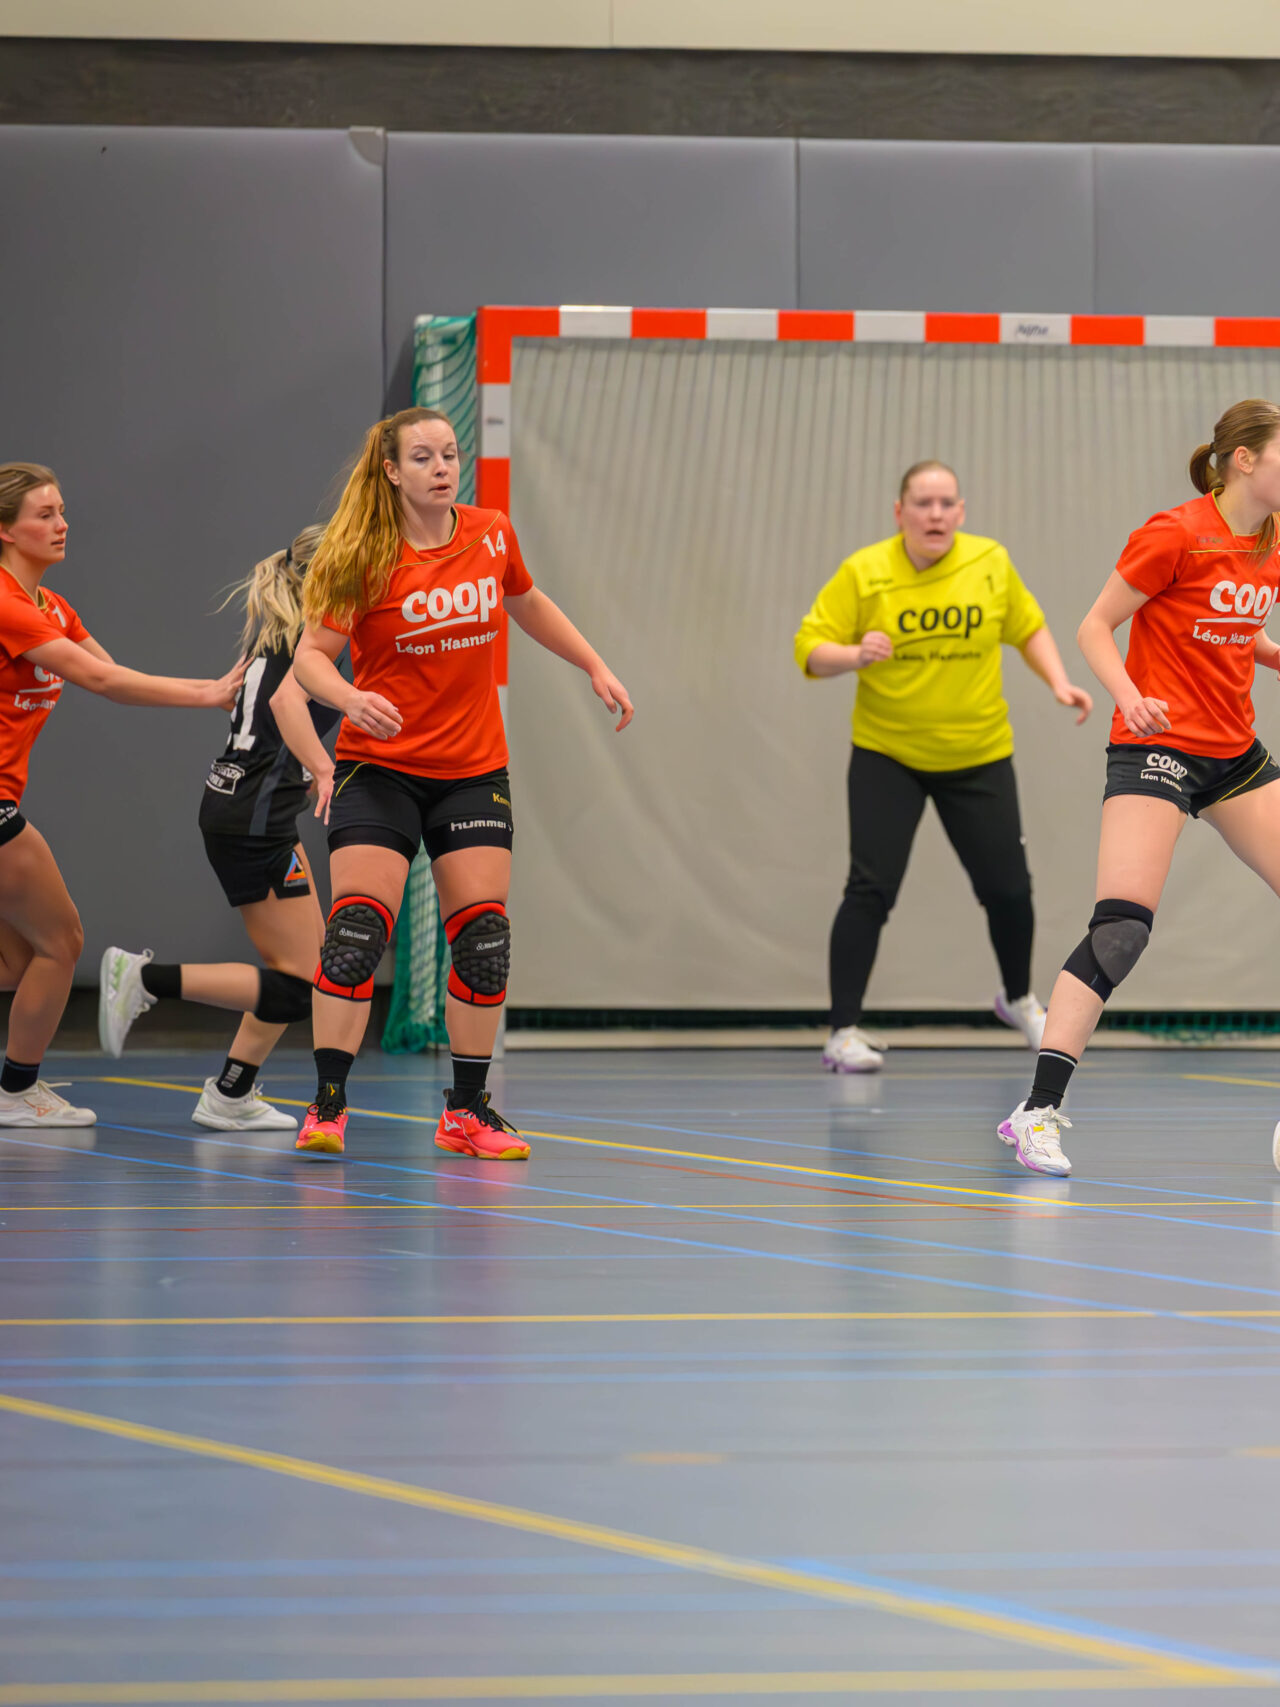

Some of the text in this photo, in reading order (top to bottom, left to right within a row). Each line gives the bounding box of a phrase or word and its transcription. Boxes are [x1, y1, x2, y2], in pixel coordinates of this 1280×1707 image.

[482, 530, 506, 557] 14
[402, 576, 498, 623] coop
[52, 605, 67, 628] 1
[898, 605, 982, 639] coop
[395, 641, 436, 656] Léon
[227, 656, 267, 751] 1
[1146, 753, 1188, 780] coop
